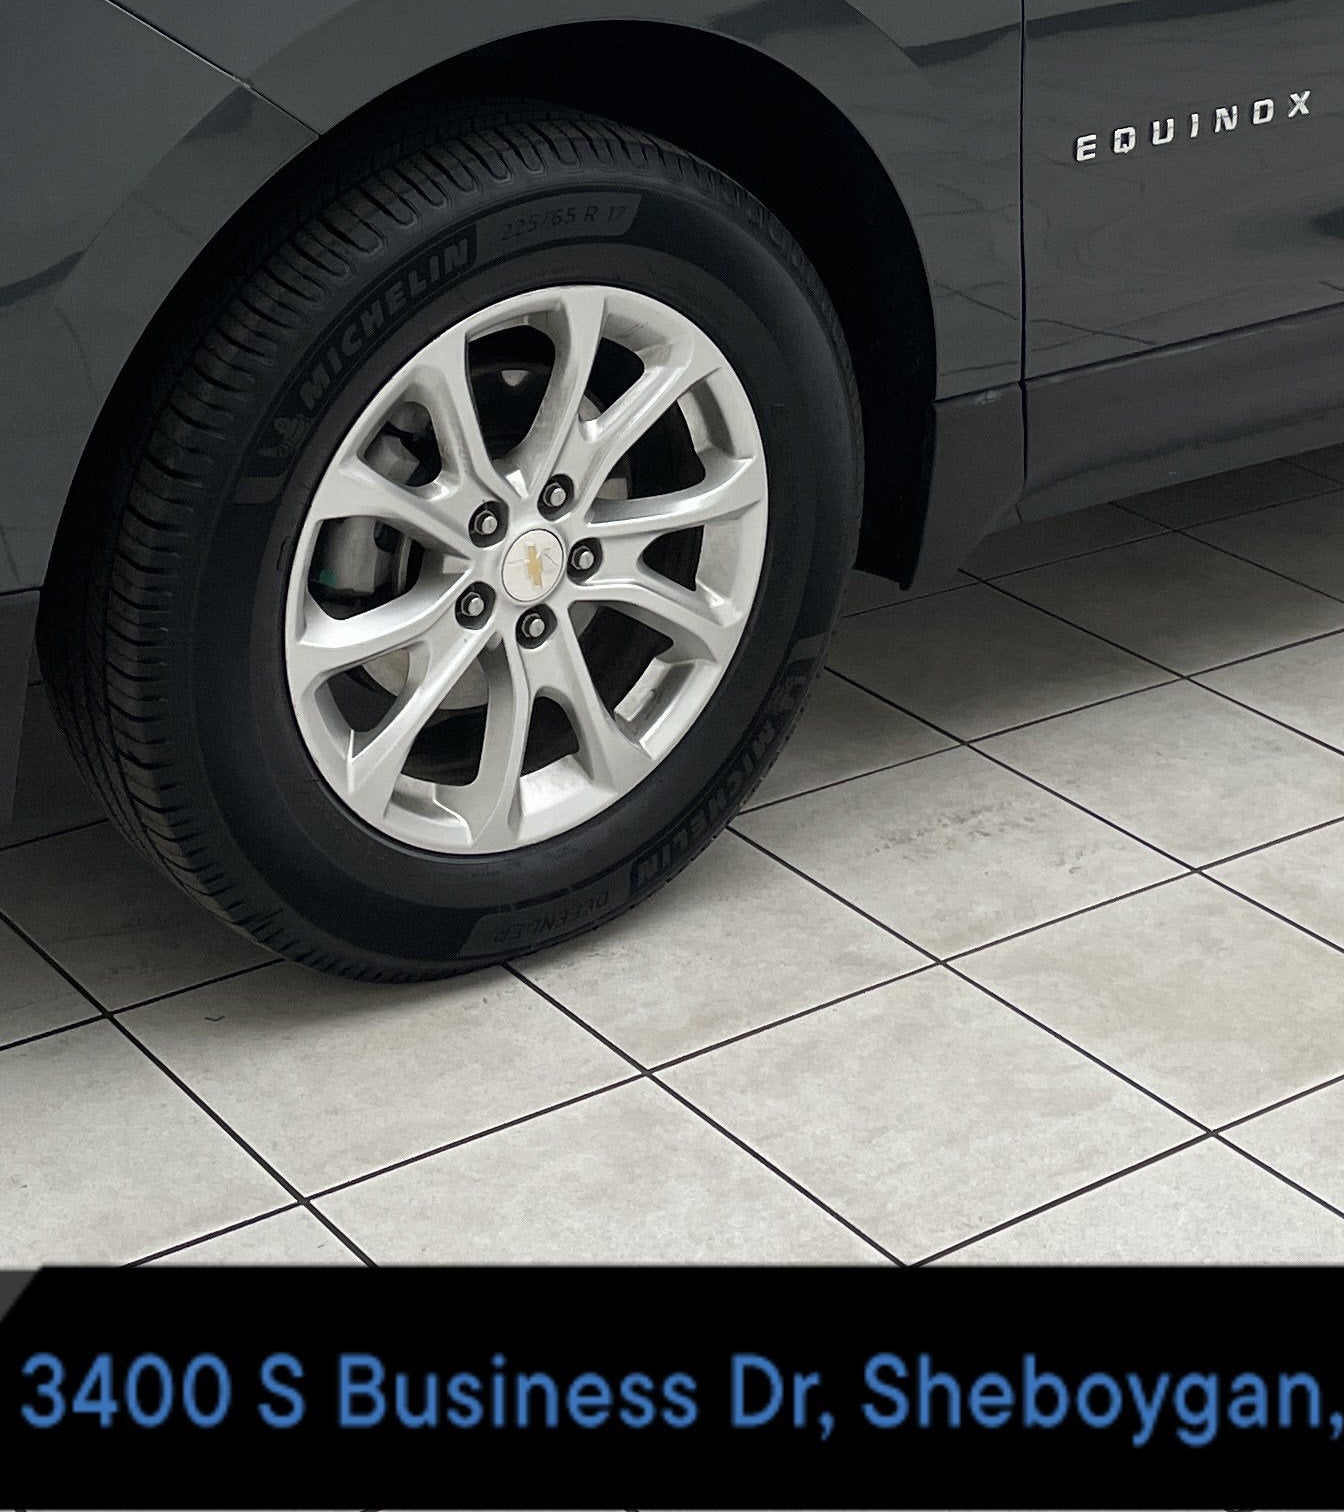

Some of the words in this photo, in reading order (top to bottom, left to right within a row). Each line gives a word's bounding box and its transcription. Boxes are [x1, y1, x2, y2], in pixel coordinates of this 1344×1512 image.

[1076, 90, 1311, 162] EQUINOX
[299, 235, 472, 410] MICHELIN
[636, 723, 776, 890] MICHELIN
